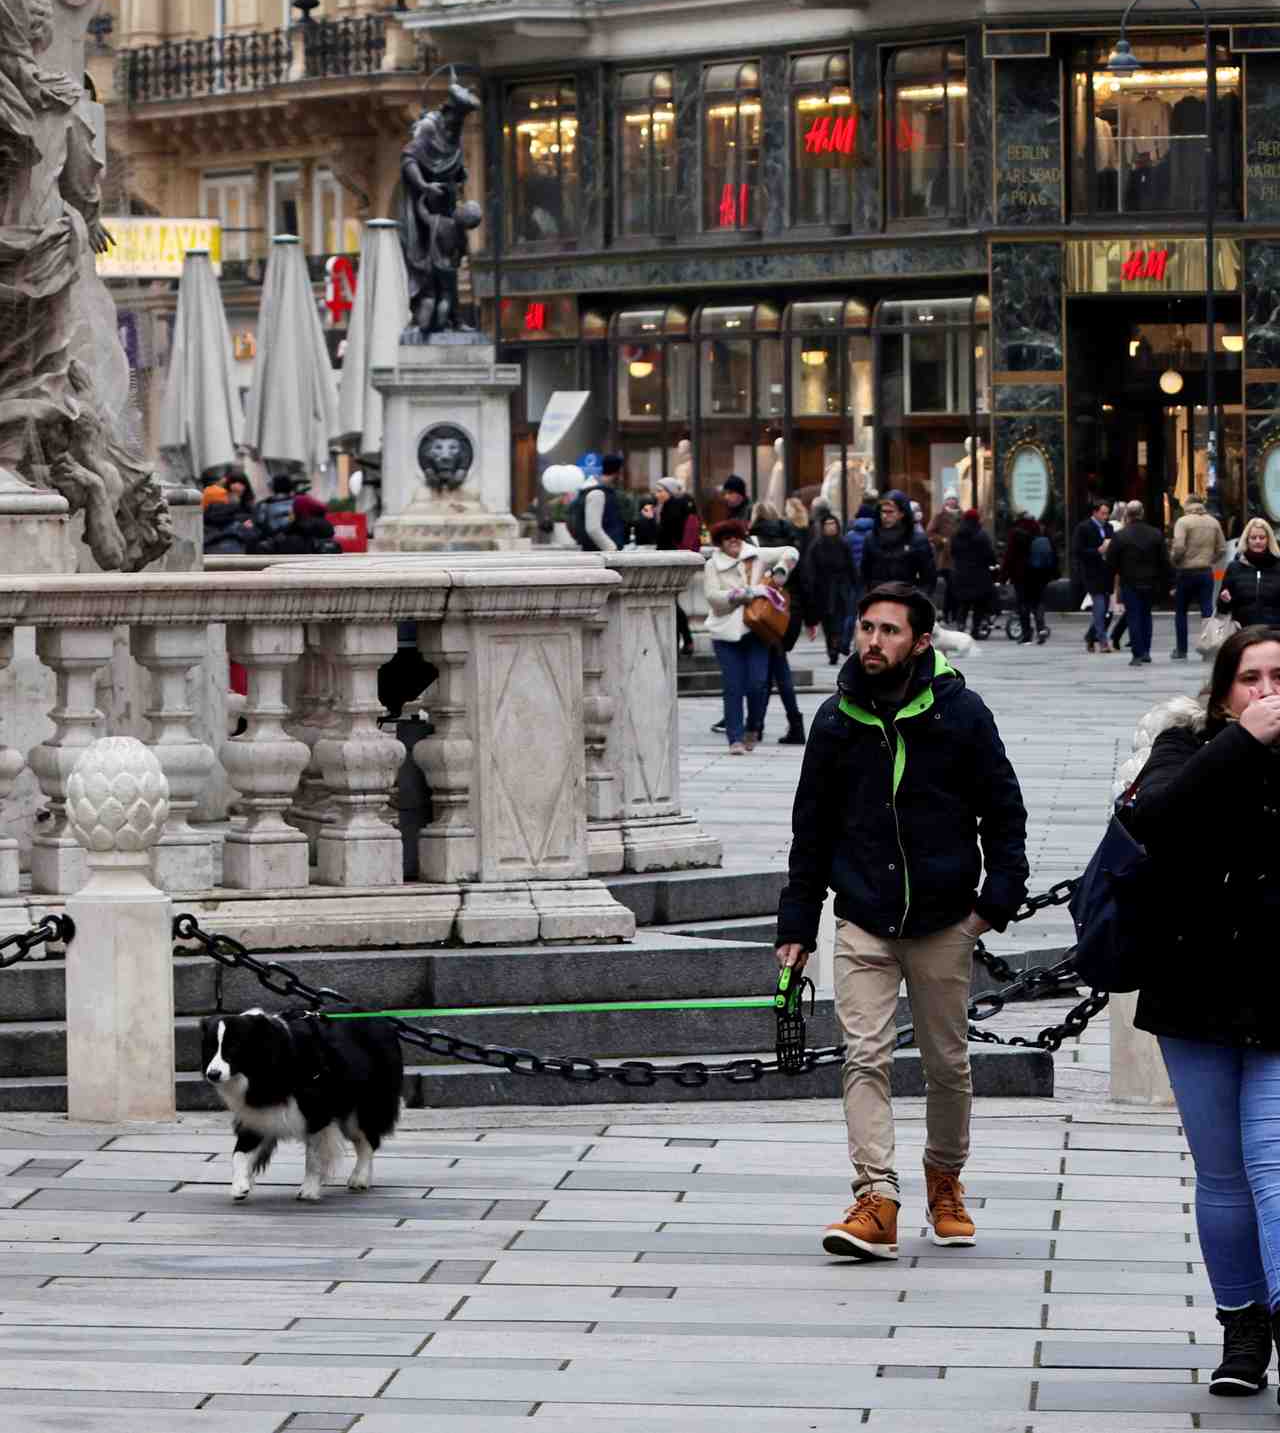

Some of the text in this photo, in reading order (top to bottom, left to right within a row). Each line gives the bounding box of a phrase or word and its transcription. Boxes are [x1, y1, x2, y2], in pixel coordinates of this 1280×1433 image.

[1008, 143, 1049, 160] BERLIN
[1010, 190, 1047, 207] PRAG
[1119, 249, 1168, 281] H&M
